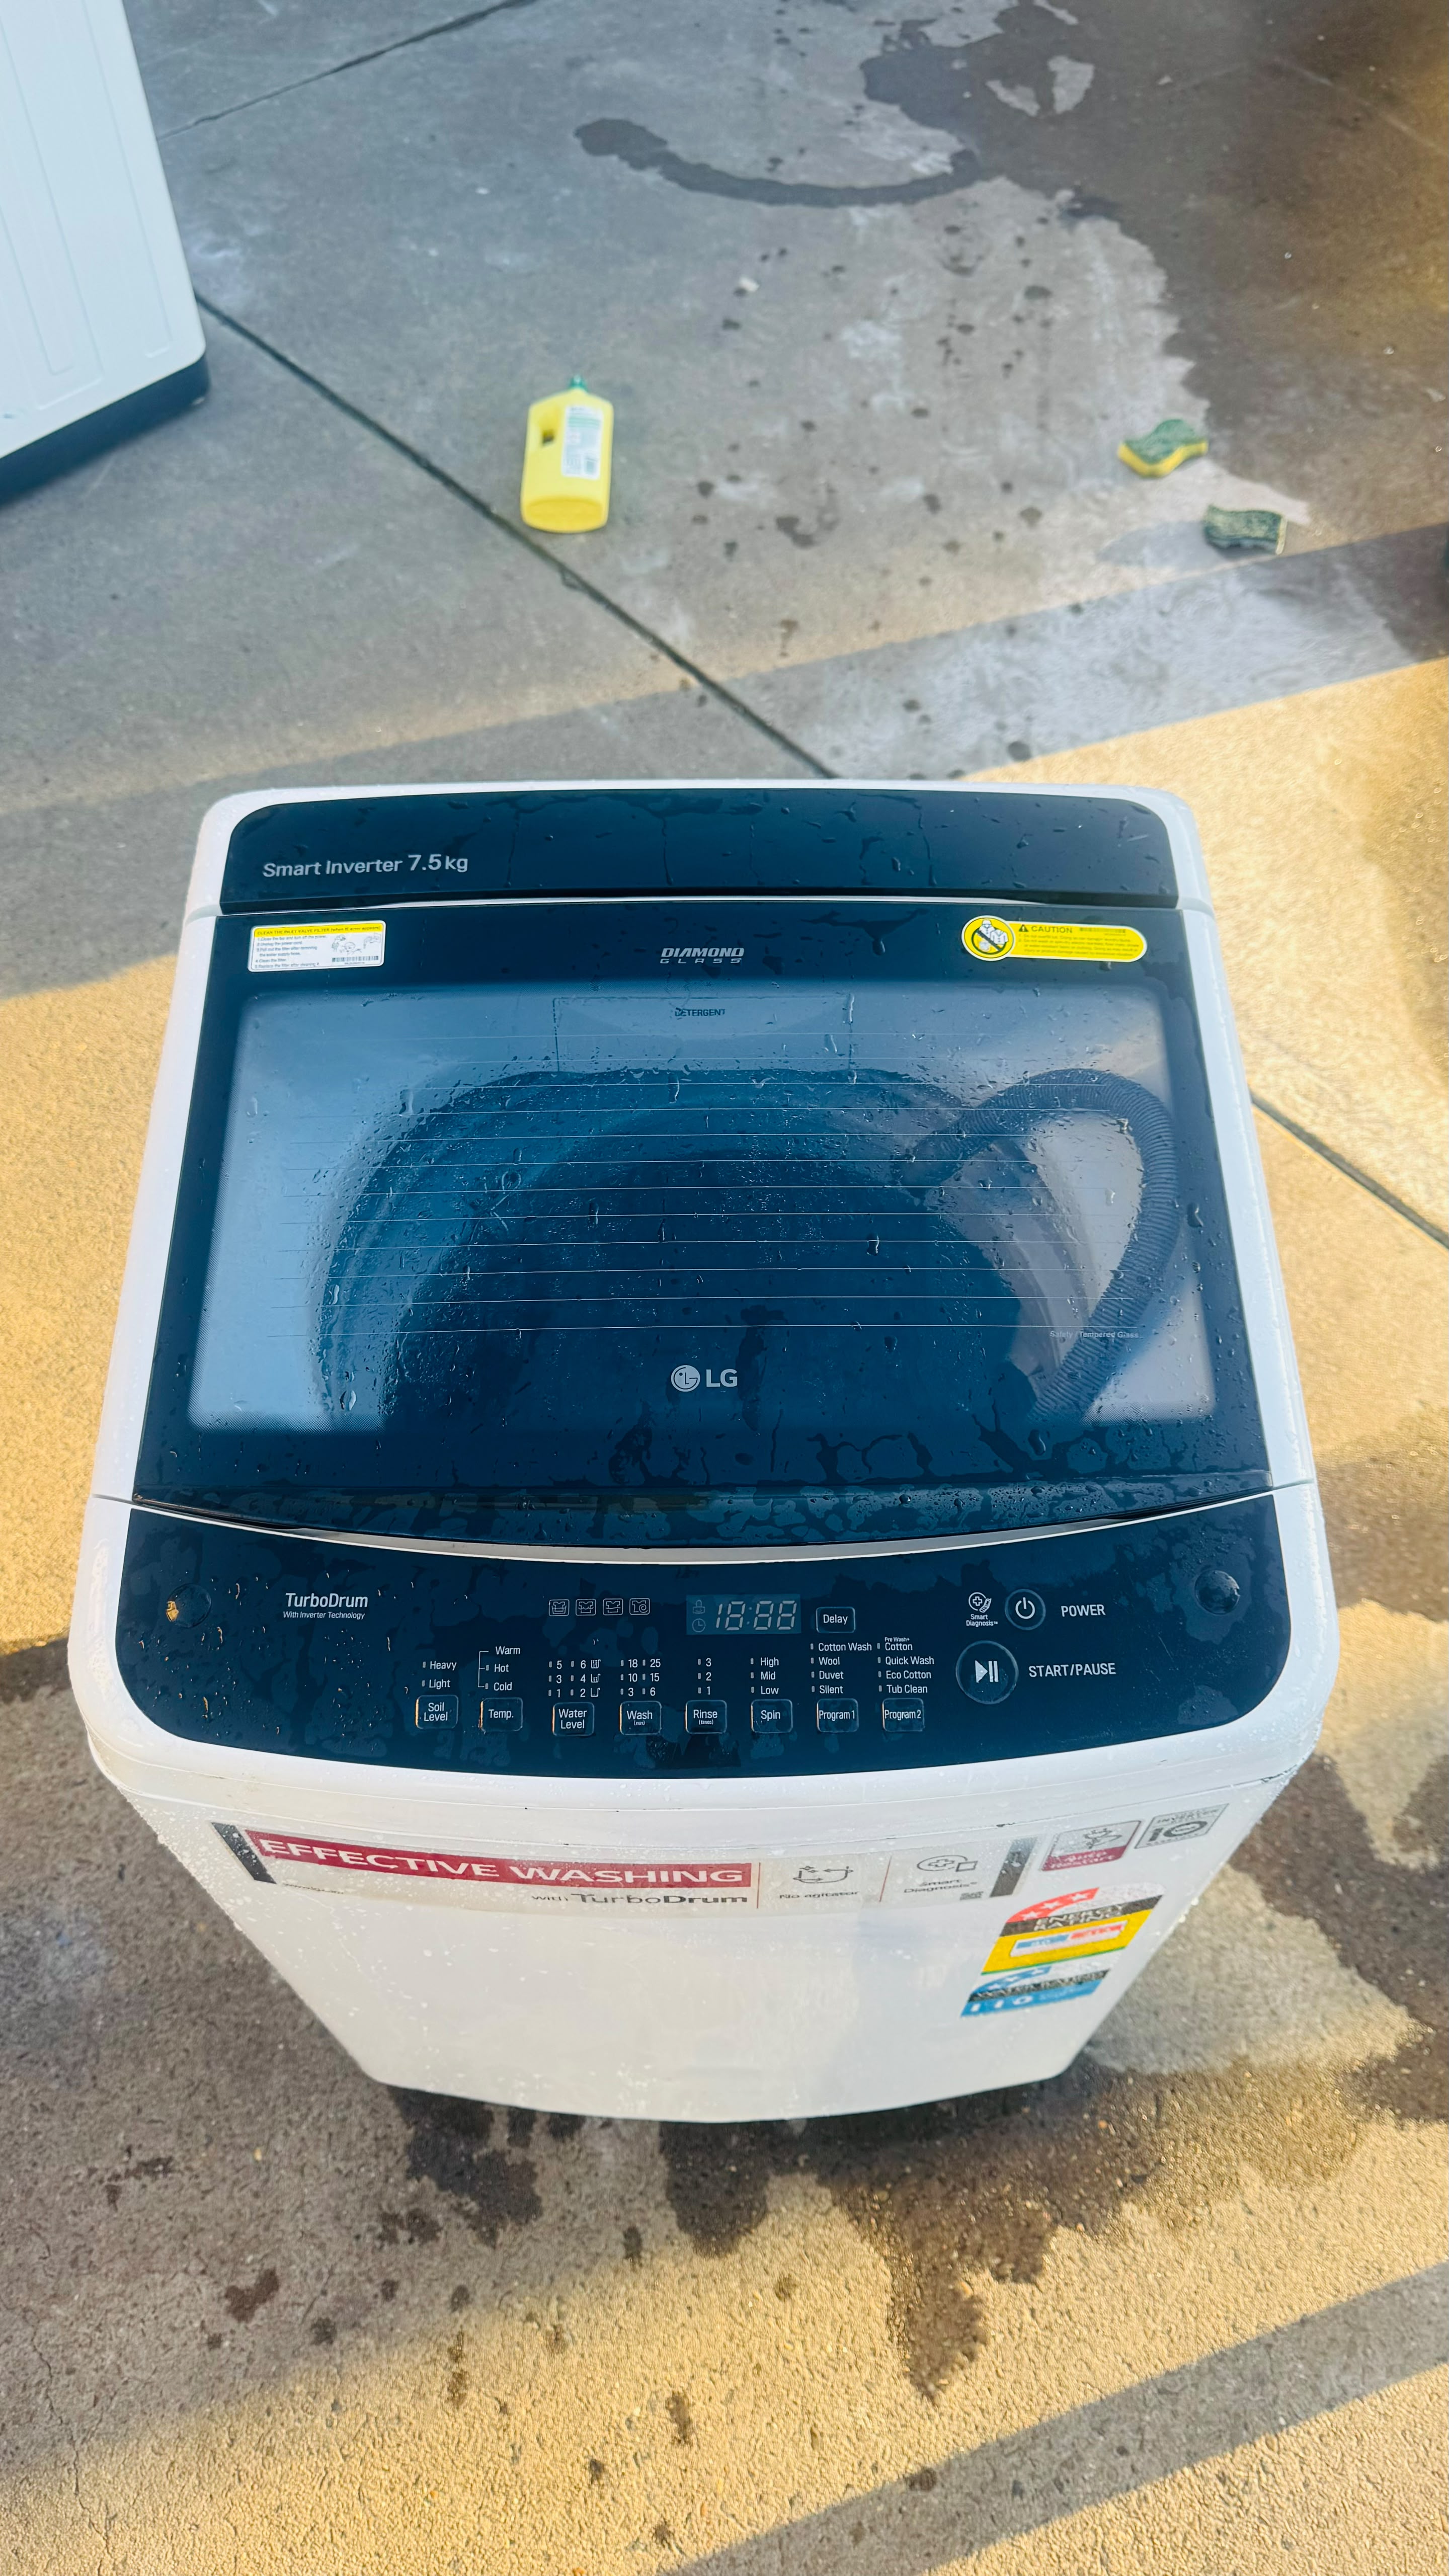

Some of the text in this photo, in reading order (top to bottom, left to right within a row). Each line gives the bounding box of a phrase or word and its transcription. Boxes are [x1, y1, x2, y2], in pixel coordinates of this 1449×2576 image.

[263, 862, 321, 877] Smart
[326, 859, 403, 874] Inverter
[1031, 925, 1073, 933] CAUTION
[661, 948, 744, 957] DIAMOND
[675, 1008, 725, 1016] DETERGENT
[1080, 1331, 1115, 1339] Tempered
[706, 1369, 738, 1387] LG
[285, 1593, 368, 1607] TurboDrum
[1061, 1604, 1106, 1617] POWER
[328, 1612, 365, 1620] Technology
[823, 1614, 848, 1625] Delay
[495, 1646, 521, 1655] Warm
[818, 1642, 872, 1651] Cotton Wash
[885, 1642, 913, 1651] Cotton
[556, 1660, 586, 1669] 5 6
[628, 1659, 661, 1668] 18 25
[706, 1658, 711, 1667] 3
[760, 1657, 779, 1667] High
[819, 1656, 840, 1665] Wool
[886, 1656, 934, 1666] Quick Wash
[430, 1661, 457, 1671] Heavy
[494, 1664, 509, 1672] Hot
[1028, 1663, 1116, 1677] START/PAUSE
[556, 1674, 586, 1683] 3 4
[628, 1673, 660, 1682] 10 15
[706, 1672, 711, 1681] 2
[761, 1671, 776, 1680] Mid
[819, 1670, 844, 1679] Duvet
[886, 1670, 931, 1679] Eco Cotton
[429, 1679, 451, 1689] Light
[494, 1682, 512, 1691] Cold
[556, 1688, 586, 1698] 1 2
[628, 1687, 656, 1697] 3 6
[706, 1686, 710, 1695] 1
[761, 1686, 779, 1695] Low
[819, 1685, 843, 1694] Silent
[887, 1684, 928, 1694] Tub Clean
[428, 1702, 445, 1712] Soil
[424, 1712, 448, 1721] Level
[488, 1709, 514, 1720] Temp.
[558, 1709, 587, 1718] Water
[626, 1710, 653, 1720] Wash
[693, 1710, 717, 1719] Rinse
[761, 1710, 780, 1721] Spin
[560, 1719, 585, 1729] Level
[259, 1838, 742, 1883] EFFECTIVE WASHING
[571, 1893, 748, 1903] TurboDrum
